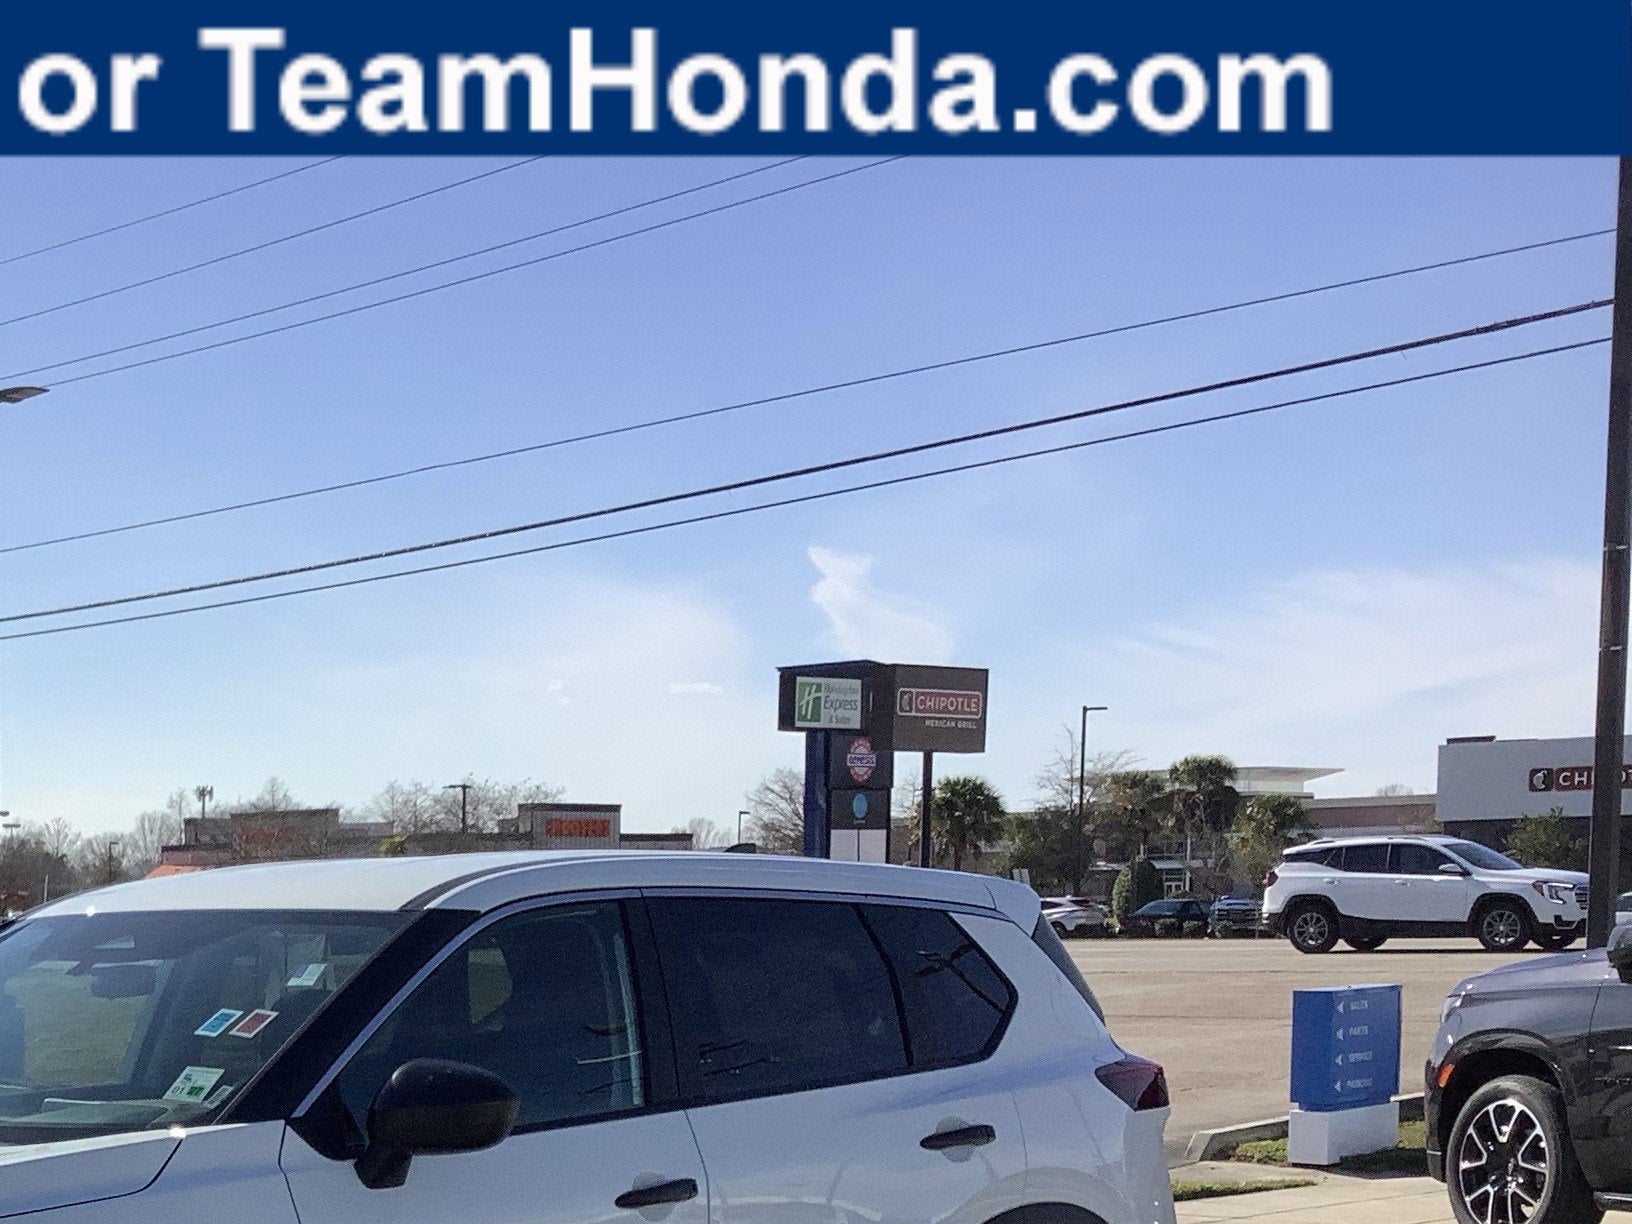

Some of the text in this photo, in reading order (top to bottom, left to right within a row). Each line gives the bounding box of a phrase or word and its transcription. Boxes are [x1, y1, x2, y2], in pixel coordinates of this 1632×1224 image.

[823, 694, 859, 713] Express
[916, 695, 978, 712] CHIPOTLE
[925, 719, 977, 730] MEXICAN GRILL
